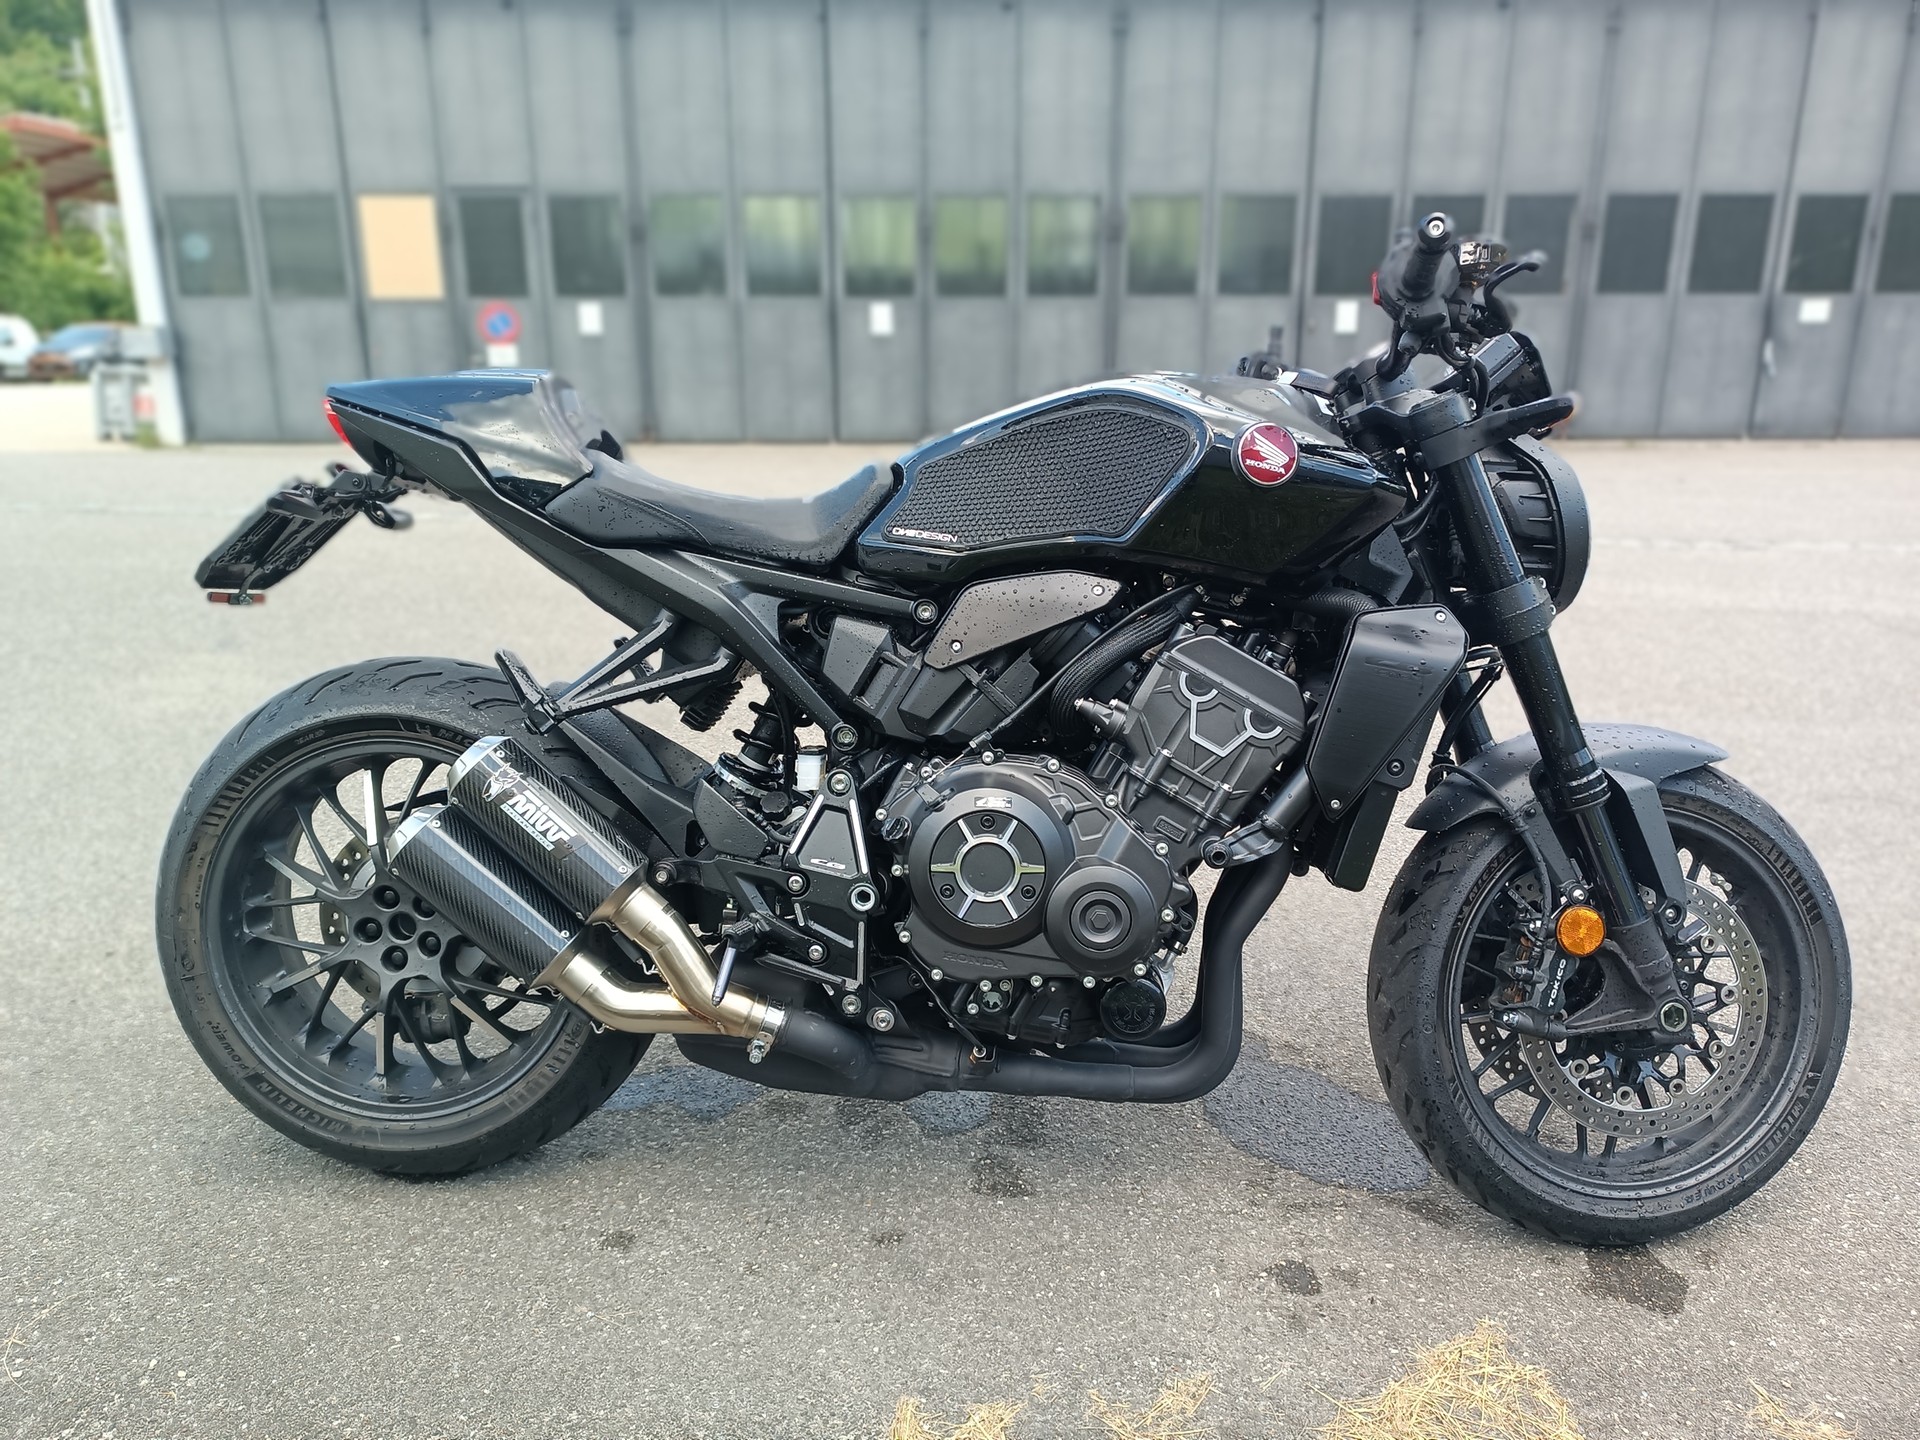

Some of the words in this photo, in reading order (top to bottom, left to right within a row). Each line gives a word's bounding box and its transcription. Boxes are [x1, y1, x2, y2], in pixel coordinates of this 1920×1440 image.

[1245, 458, 1286, 475] HONDA
[502, 805, 529, 829] ITALIAN
[531, 830, 553, 848] STYLE
[942, 951, 1009, 971] HONDA
[1548, 958, 1566, 1008] TOKICO
[256, 1081, 346, 1133] MICHELIN
[1742, 1101, 1804, 1172] MICHELIN
